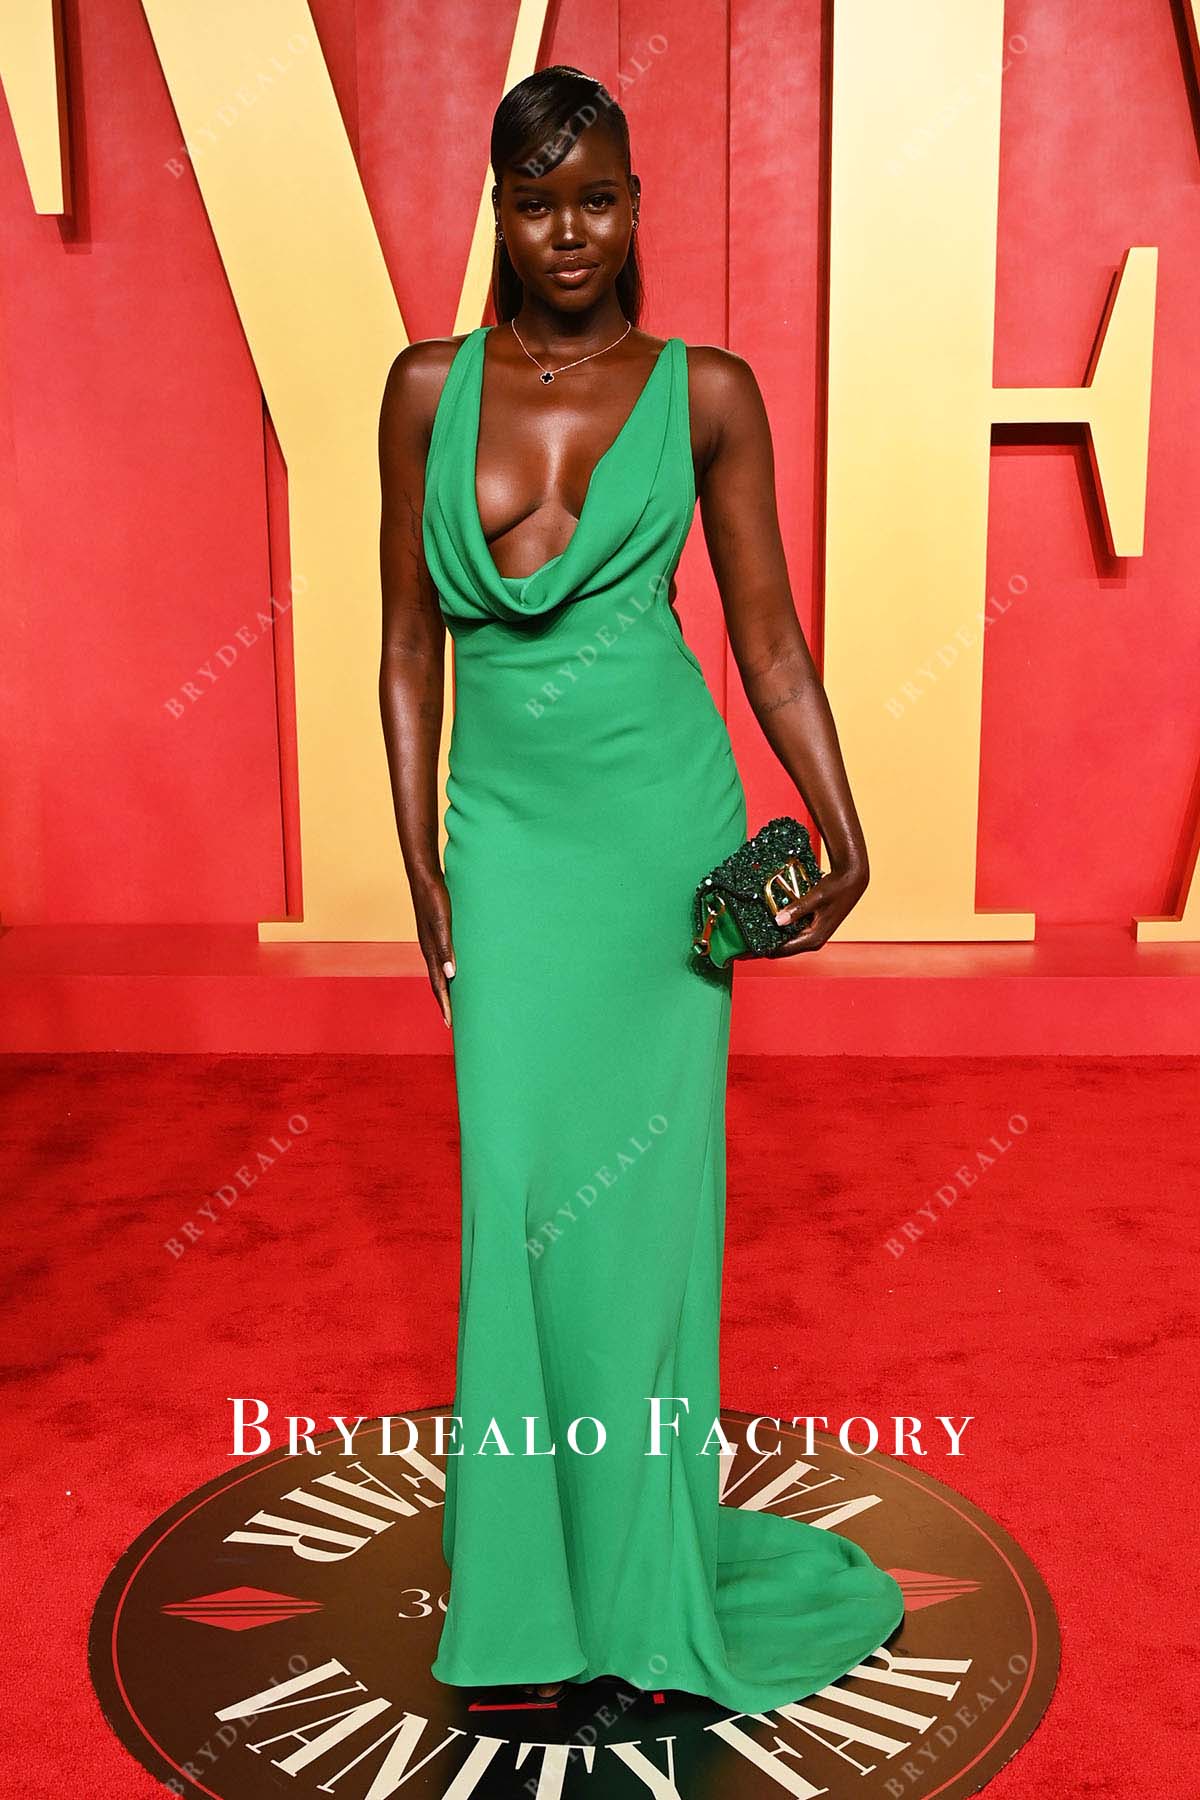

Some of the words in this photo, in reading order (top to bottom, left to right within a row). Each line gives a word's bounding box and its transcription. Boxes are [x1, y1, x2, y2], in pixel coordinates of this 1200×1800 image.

[398, 1588, 448, 1618] 3
[214, 1658, 678, 1800] VANITY
[703, 1646, 973, 1800] FAIR
